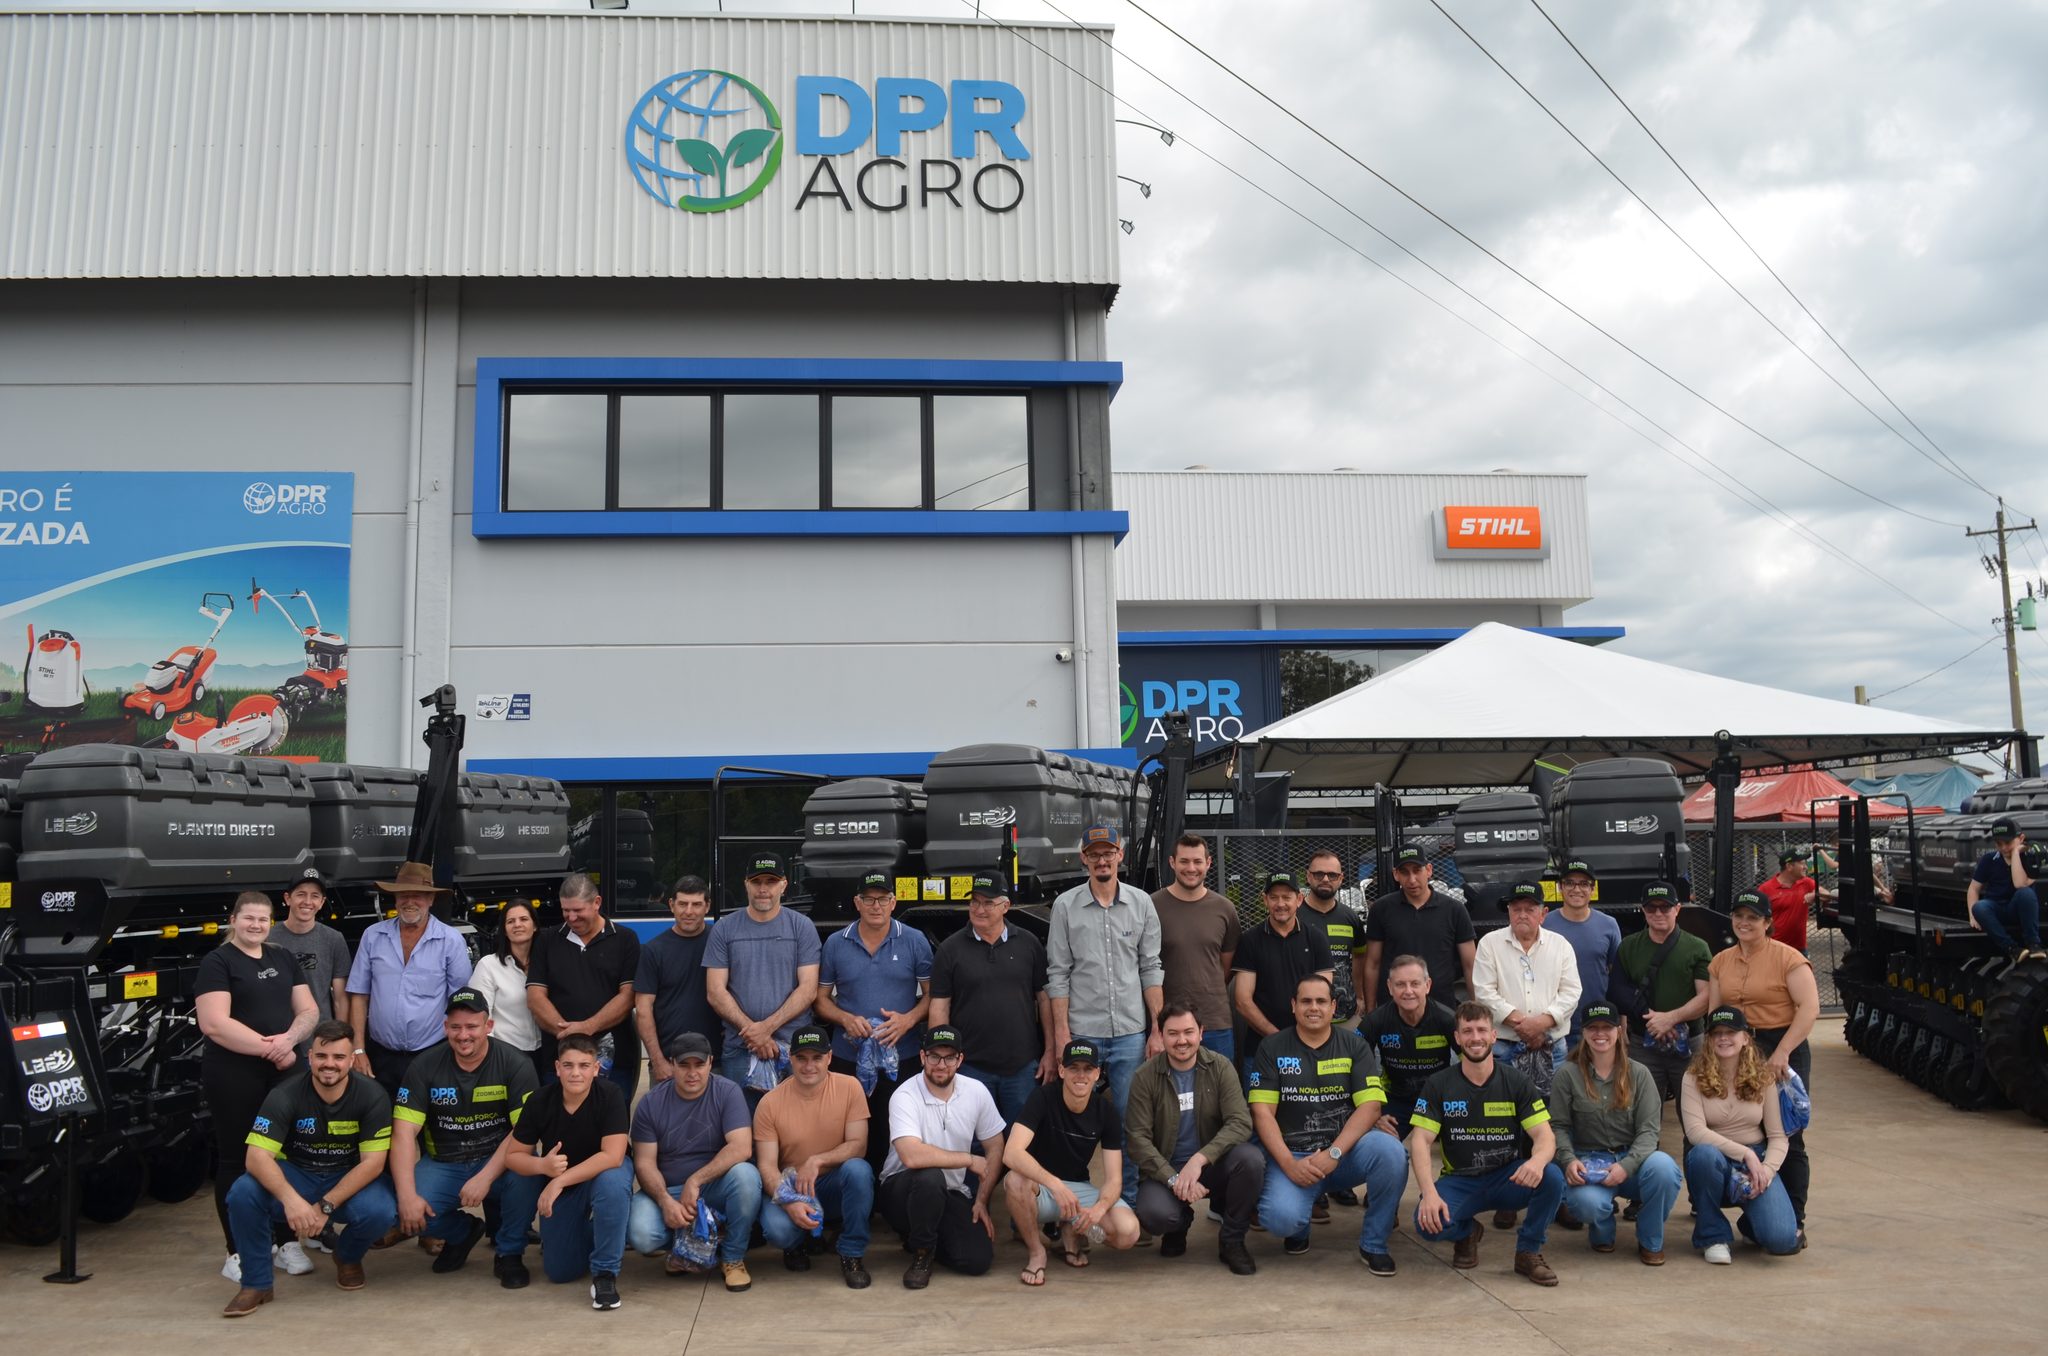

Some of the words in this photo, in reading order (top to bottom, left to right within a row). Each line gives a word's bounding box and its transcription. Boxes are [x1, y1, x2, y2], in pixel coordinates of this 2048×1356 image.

[796, 75, 1031, 161] DPR
[794, 157, 1026, 213] AGRO
[55, 482, 73, 511] É
[277, 484, 327, 503] DPR
[277, 502, 326, 515] AGRO
[1459, 518, 1531, 535] STIHL
[1142, 679, 1243, 718] DPR
[1144, 716, 1244, 743] ARO
[168, 822, 226, 836] PLANTIO
[229, 824, 276, 836] DIRETO
[518, 826, 530, 835] HE
[531, 826, 550, 835] 5500
[813, 822, 836, 835] SE
[838, 821, 880, 835] 5000
[1464, 831, 1488, 843] SE
[1494, 829, 1540, 842] 4000
[55, 891, 75, 902] DPR
[1277, 1057, 1300, 1068] DPR
[48, 1077, 84, 1098] DPR
[430, 1088, 456, 1098] DPR
[1320, 1085, 1344, 1094] FORÇA
[56, 1091, 87, 1108] AGRO
[1287, 1094, 1308, 1102] HORA
[1443, 1101, 1467, 1111] DPR
[1444, 1110, 1468, 1118] AGRO
[464, 1123, 475, 1131] DE
[1486, 1127, 1509, 1135] FORÇA
